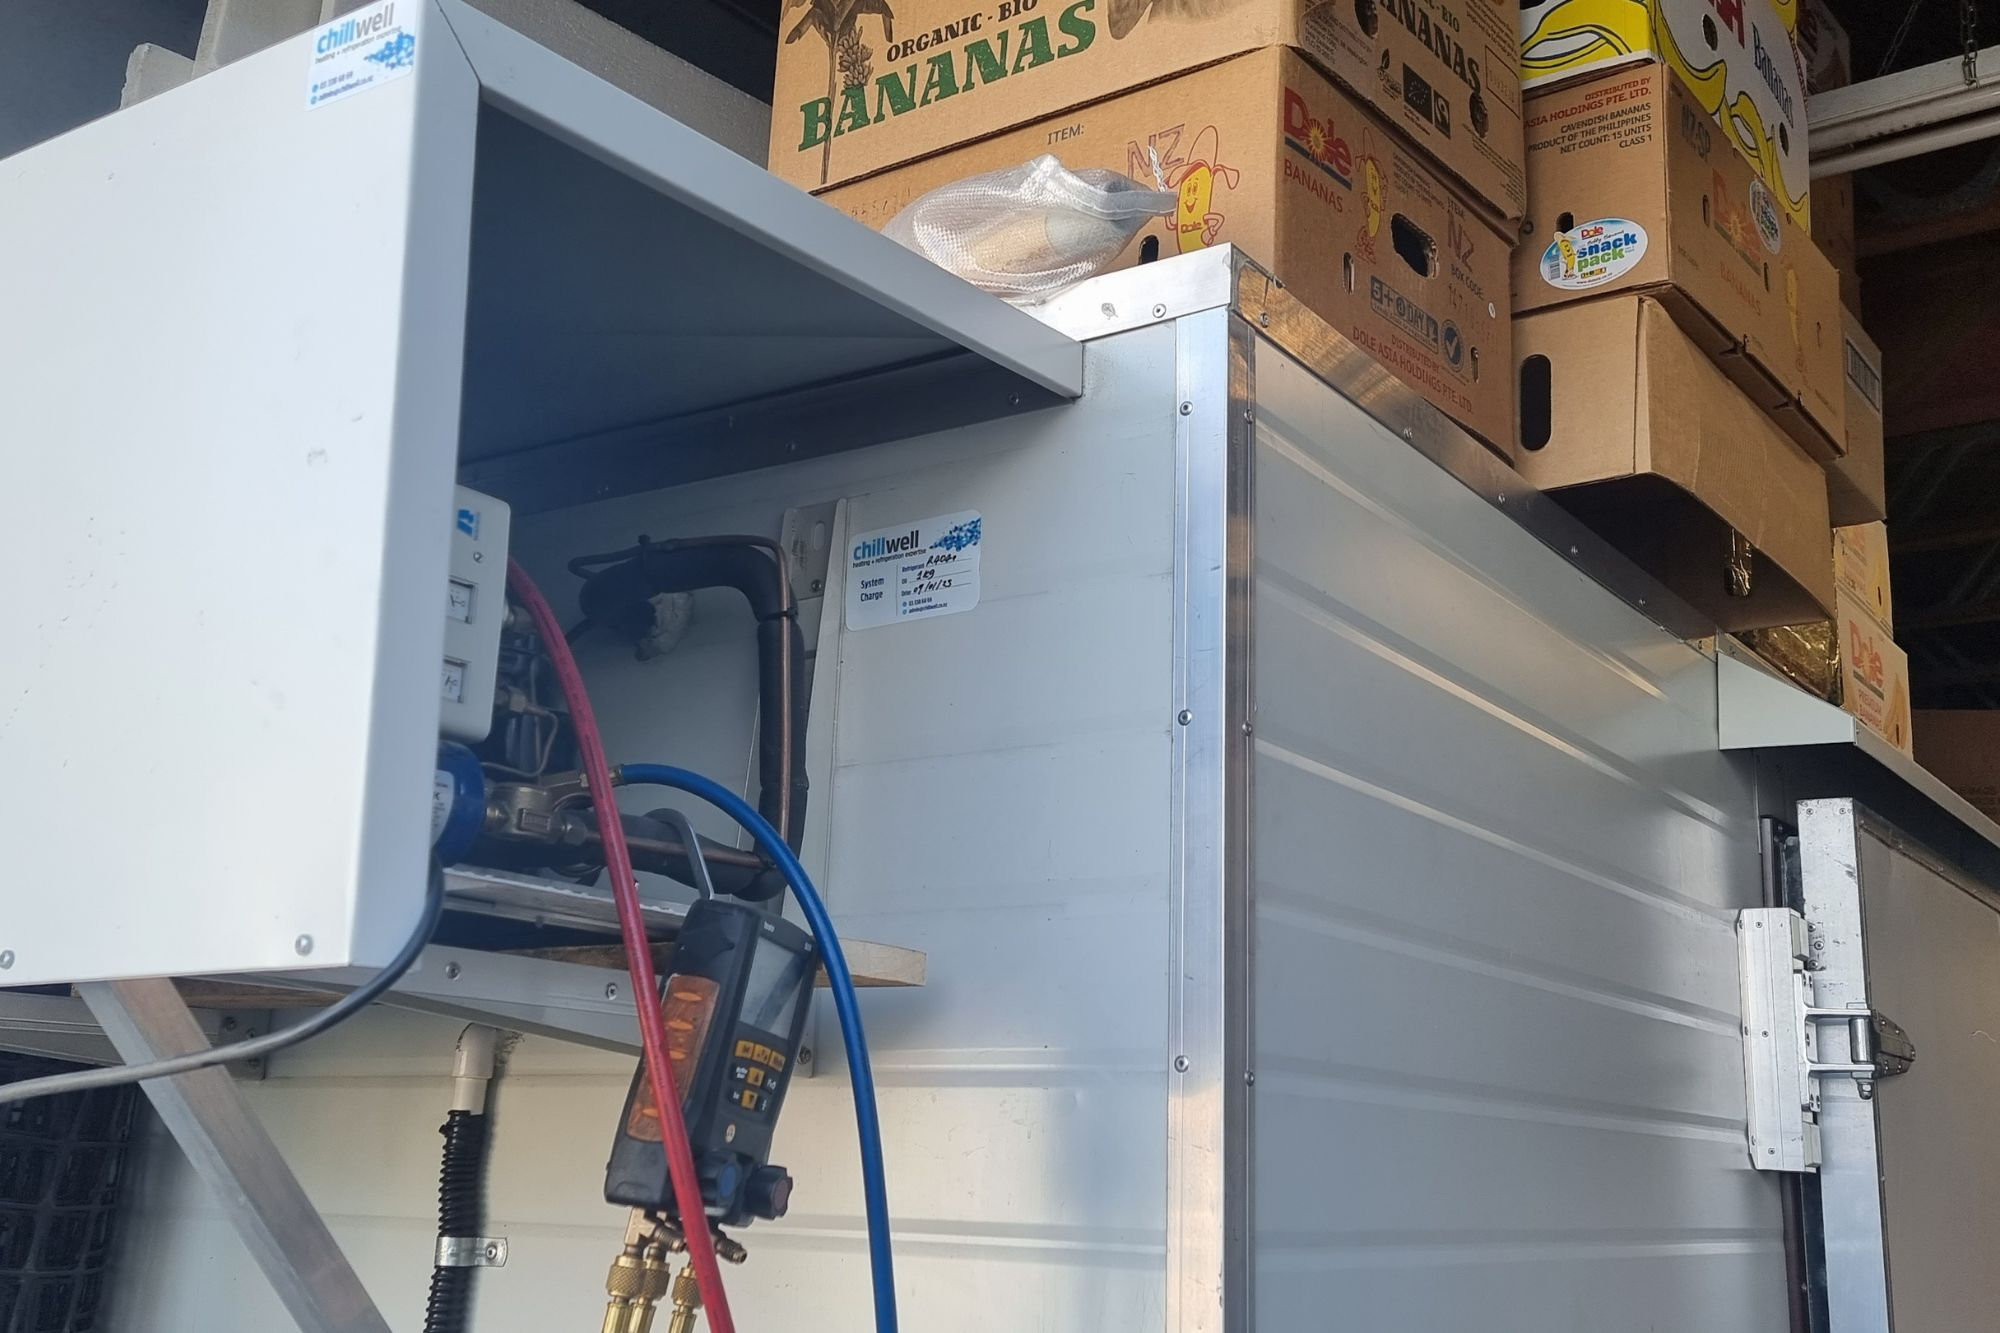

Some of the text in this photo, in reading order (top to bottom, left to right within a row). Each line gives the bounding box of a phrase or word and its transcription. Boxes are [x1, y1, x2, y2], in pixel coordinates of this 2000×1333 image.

[317, 2, 395, 54] chillwell
[886, 12, 982, 63] ORGANIC
[998, 0, 1038, 23] BIO
[1441, 4, 1460, 33] BIO
[797, 0, 1098, 152] BANANAS
[1584, 76, 1652, 101] DISTRIBUTED BY
[1752, 22, 1793, 129] Bananas
[1550, 99, 1604, 122] HOLDINGS
[1630, 86, 1652, 100] LTD.
[1560, 102, 1652, 134] CAVENDISH BANANAS
[1047, 123, 1086, 146] ITEM:
[1284, 86, 1353, 177] Dole
[1527, 112, 1652, 153] PRODUCT OF THE PHILIPPINES
[1560, 123, 1652, 155] NET COUNT: 15 UNITS
[1619, 135, 1646, 149] CLASS
[1127, 123, 1186, 181] NZ
[1284, 158, 1344, 214] BANANAS
[1577, 233, 1638, 259] snack
[1577, 247, 1626, 272] pack
[1353, 326, 1376, 352] DOLE
[1378, 342, 1399, 367] ASIA
[1400, 355, 1441, 393] HOLDINGS
[1391, 334, 1431, 370] DISTRIBUTED
[853, 529, 920, 561] chillwell
[860, 577, 885, 590] System
[860, 590, 884, 603] Charge
[1849, 619, 1885, 690] Dole
